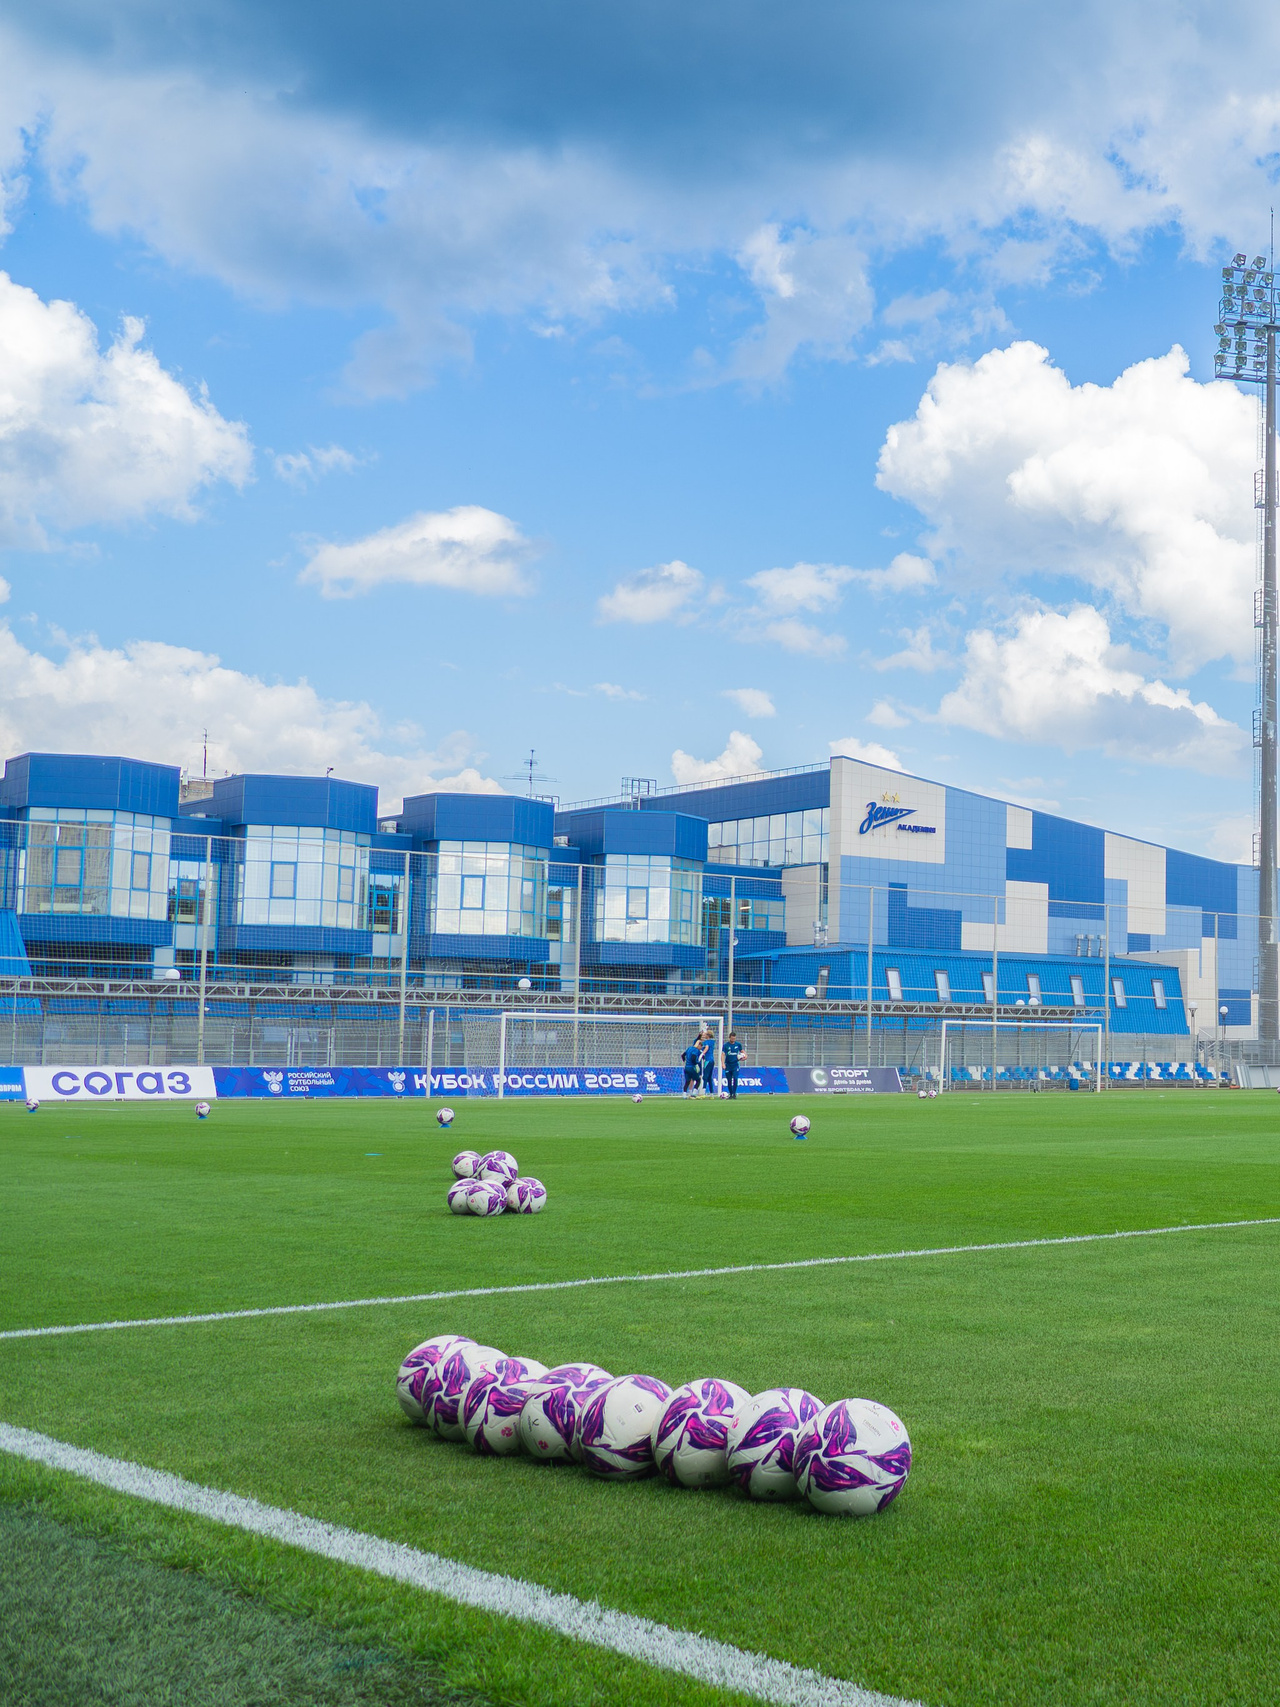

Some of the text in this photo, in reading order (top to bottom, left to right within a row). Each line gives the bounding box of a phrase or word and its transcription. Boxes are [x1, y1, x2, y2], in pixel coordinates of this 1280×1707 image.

[287, 1071, 332, 1079] РОССИЙСКИЙ
[830, 1069, 869, 1078] СПОРТ
[288, 1078, 335, 1086] ФУТБОЛЬНЫЙ
[414, 1074, 486, 1089] КУБОК
[492, 1074, 579, 1089] РОССИИ
[584, 1074, 639, 1088] 2026
[713, 1078, 763, 1087] НОАТЭК
